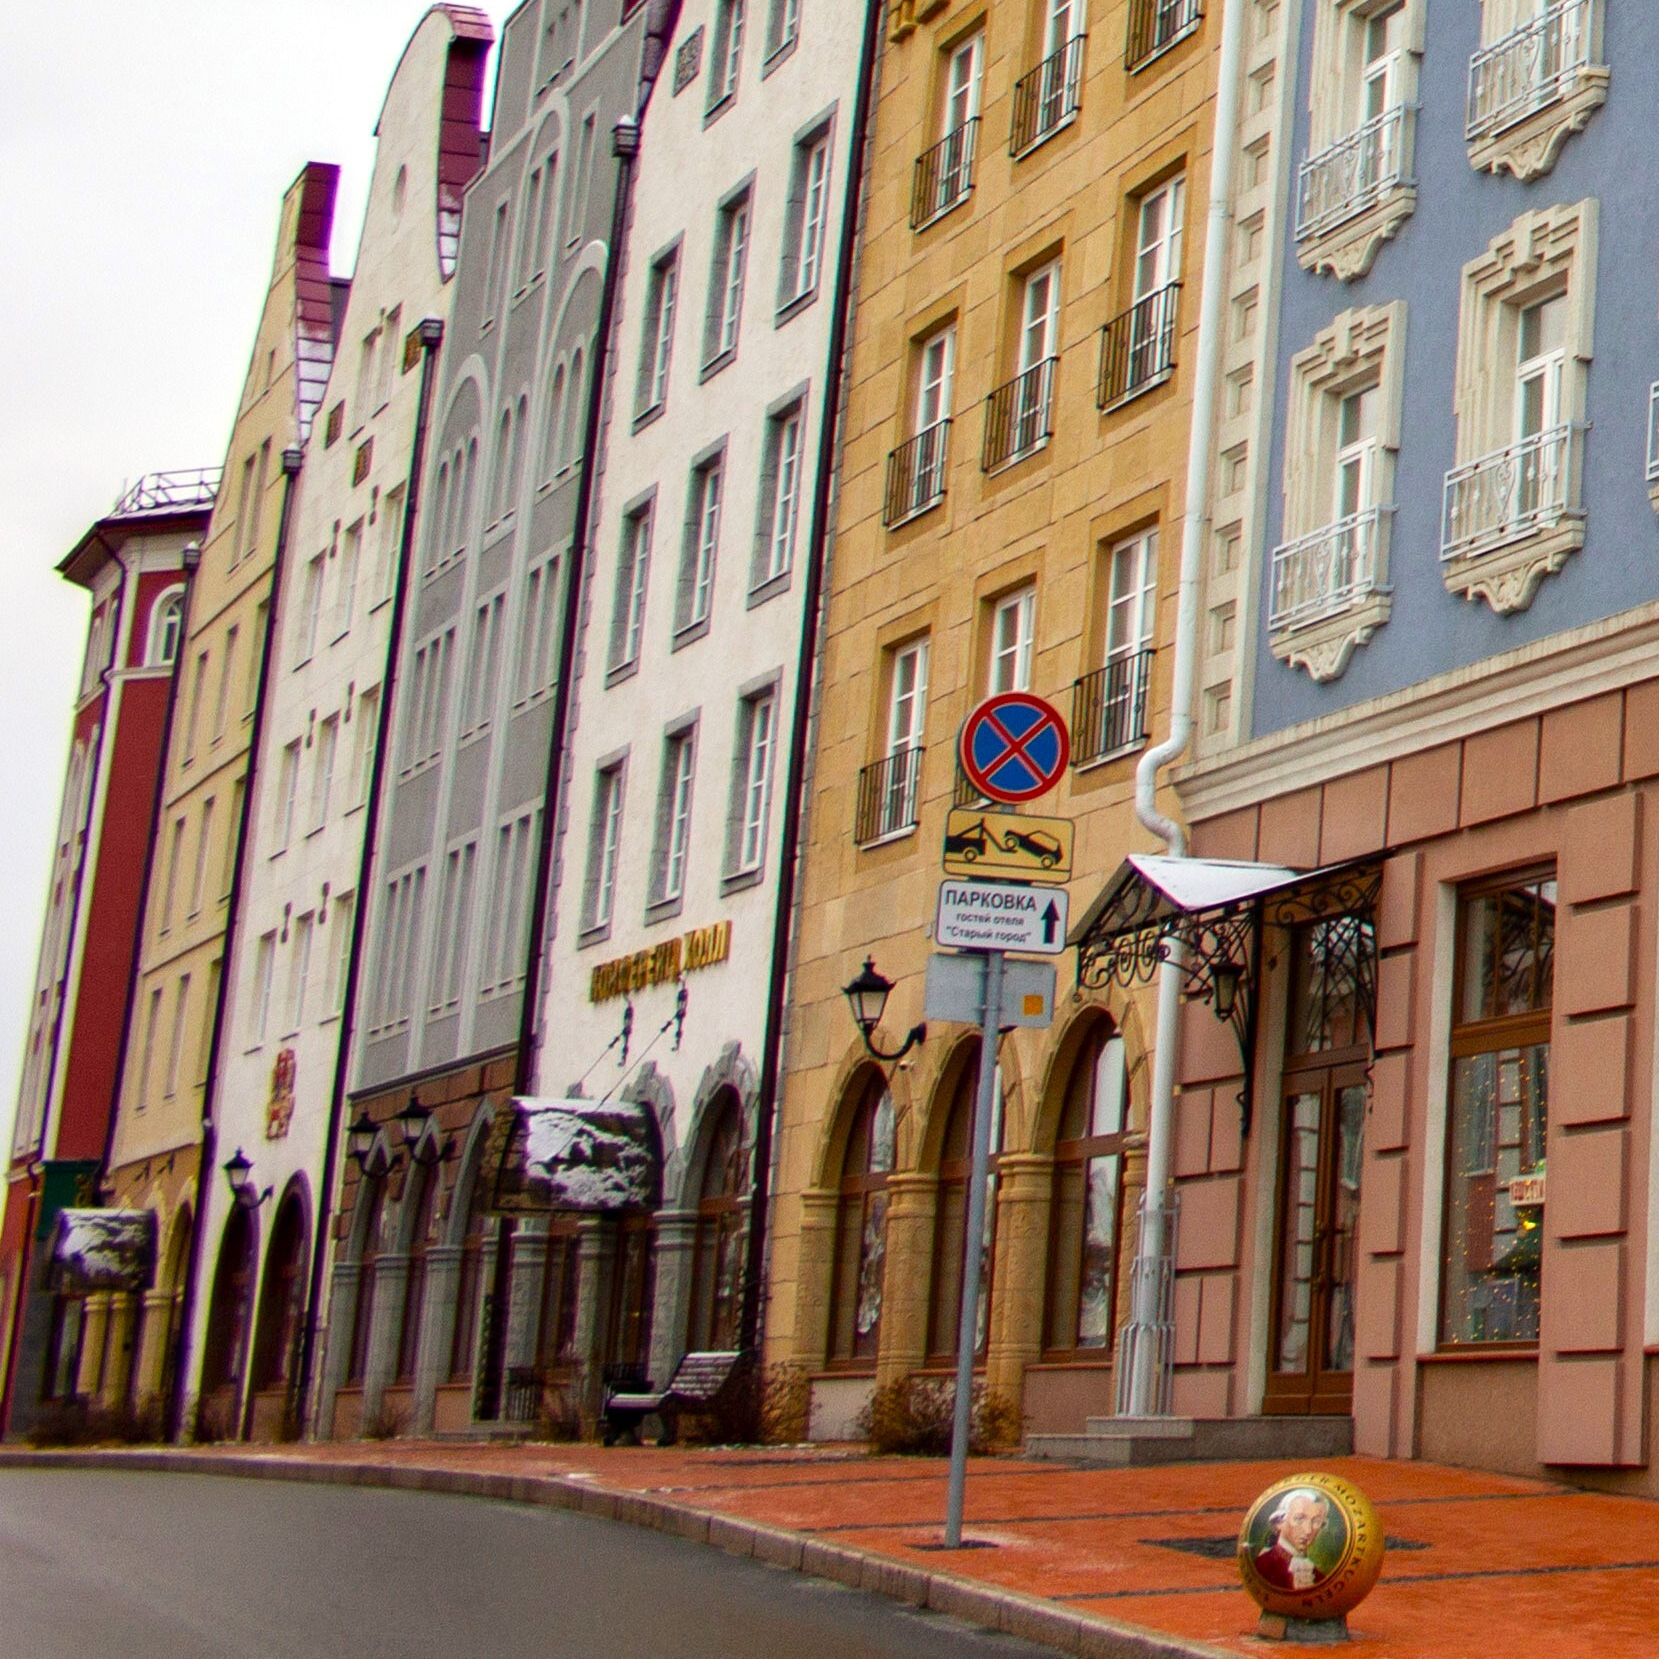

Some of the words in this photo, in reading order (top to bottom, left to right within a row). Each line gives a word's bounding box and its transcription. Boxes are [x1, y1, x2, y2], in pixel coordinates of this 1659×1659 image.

[945, 889, 1037, 911] ПАРКОВКА
[956, 913, 992, 923] гостей
[993, 916, 1025, 926] отеля
